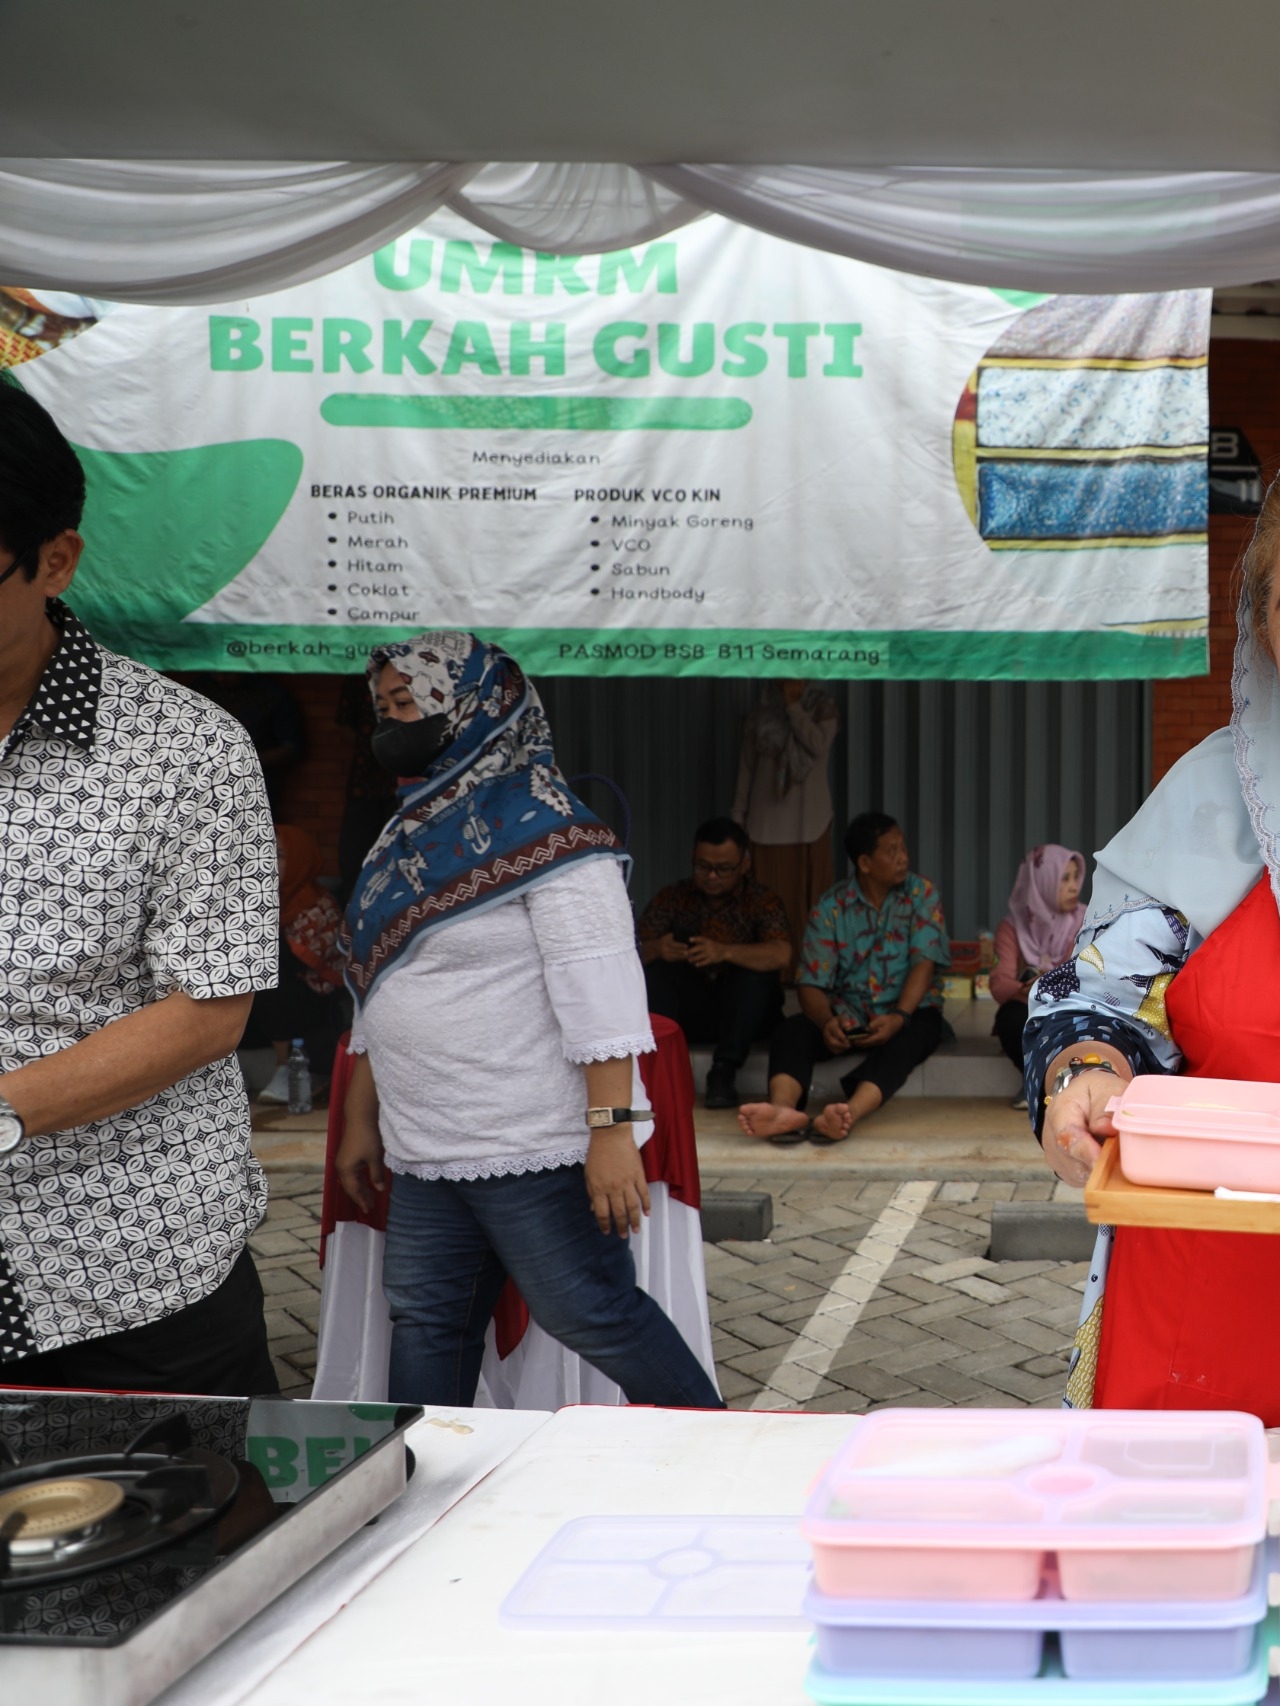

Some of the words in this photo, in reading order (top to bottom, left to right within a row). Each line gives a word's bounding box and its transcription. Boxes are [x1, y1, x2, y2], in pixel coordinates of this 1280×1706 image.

[373, 238, 678, 296] UMKM
[209, 315, 566, 376] BERKAH
[593, 321, 863, 378] GUSTI
[1211, 432, 1239, 458] B
[472, 451, 601, 467] Menyediakan
[310, 484, 367, 499] BERAS
[373, 485, 452, 500] ORGANIK
[458, 487, 537, 501] PREMIUM
[574, 488, 645, 502] PRODUK
[652, 488, 686, 502] VCO
[692, 488, 721, 502] KIN
[347, 511, 394, 525] Putih
[611, 514, 680, 531] Minyak
[686, 514, 754, 532] Goreng
[347, 535, 408, 549] Merah
[611, 538, 652, 552] VCO
[347, 559, 403, 573] Hitam
[611, 563, 670, 577] Sabun
[347, 582, 410, 598] Coklat
[611, 586, 705, 604] Handbody
[347, 606, 420, 624] Campur
[559, 643, 656, 660] PASMOD
[663, 643, 704, 660] BSB
[718, 643, 755, 660] B11
[761, 643, 880, 665] Semarang
